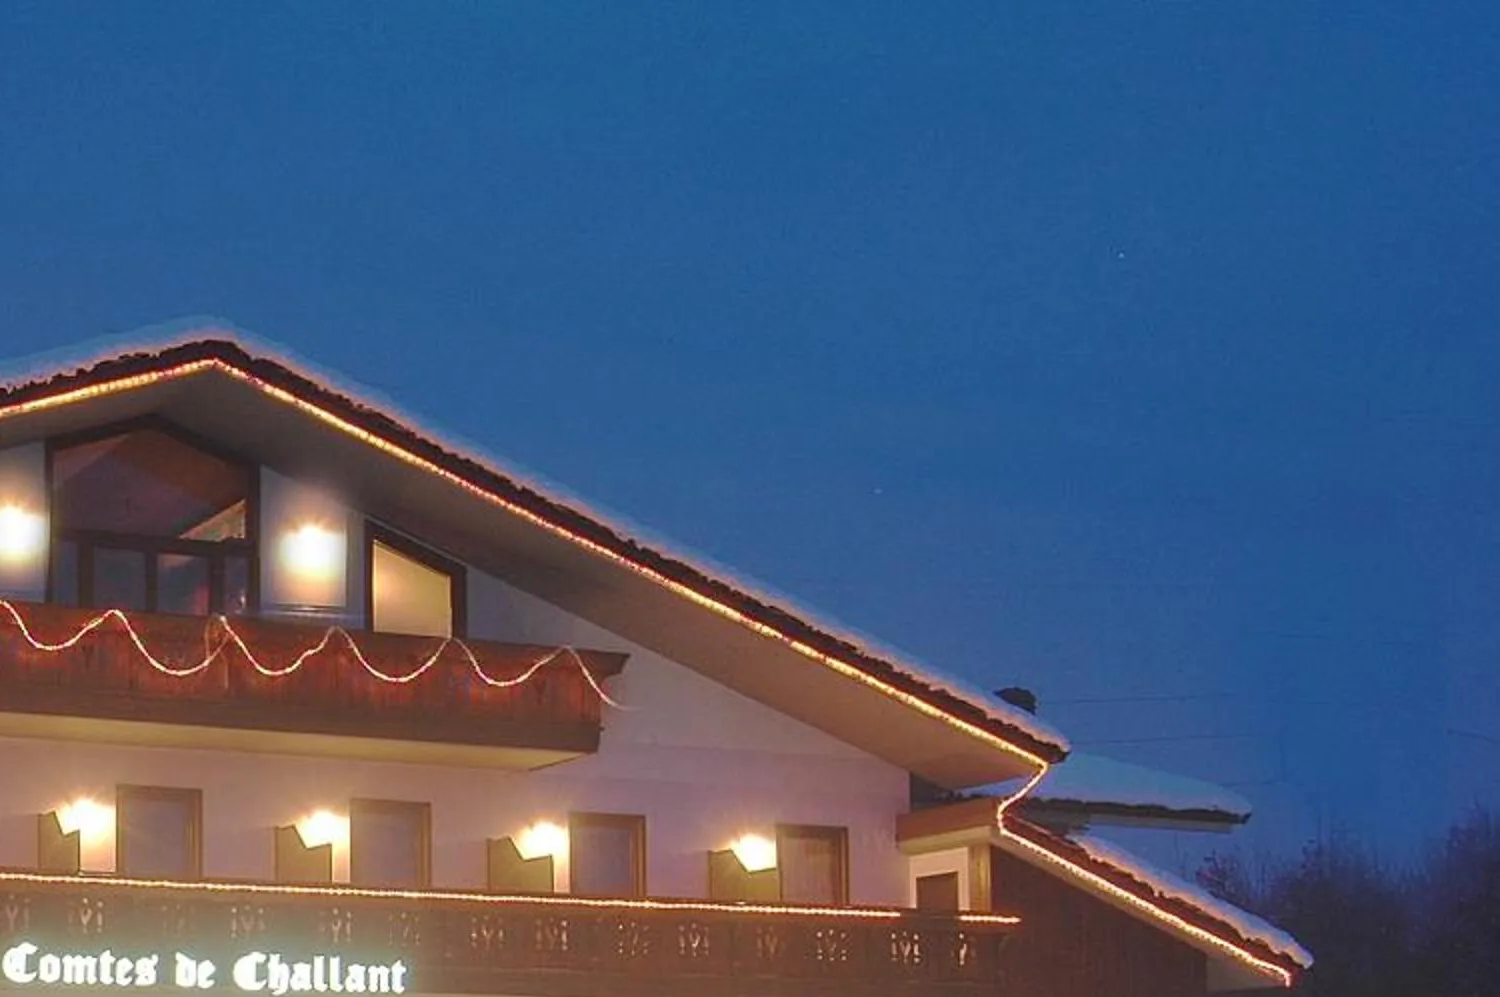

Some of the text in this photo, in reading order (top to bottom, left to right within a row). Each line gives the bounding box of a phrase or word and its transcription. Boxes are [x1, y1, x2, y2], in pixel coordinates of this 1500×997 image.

[2, 942, 406, 996] Comtes de Challant
